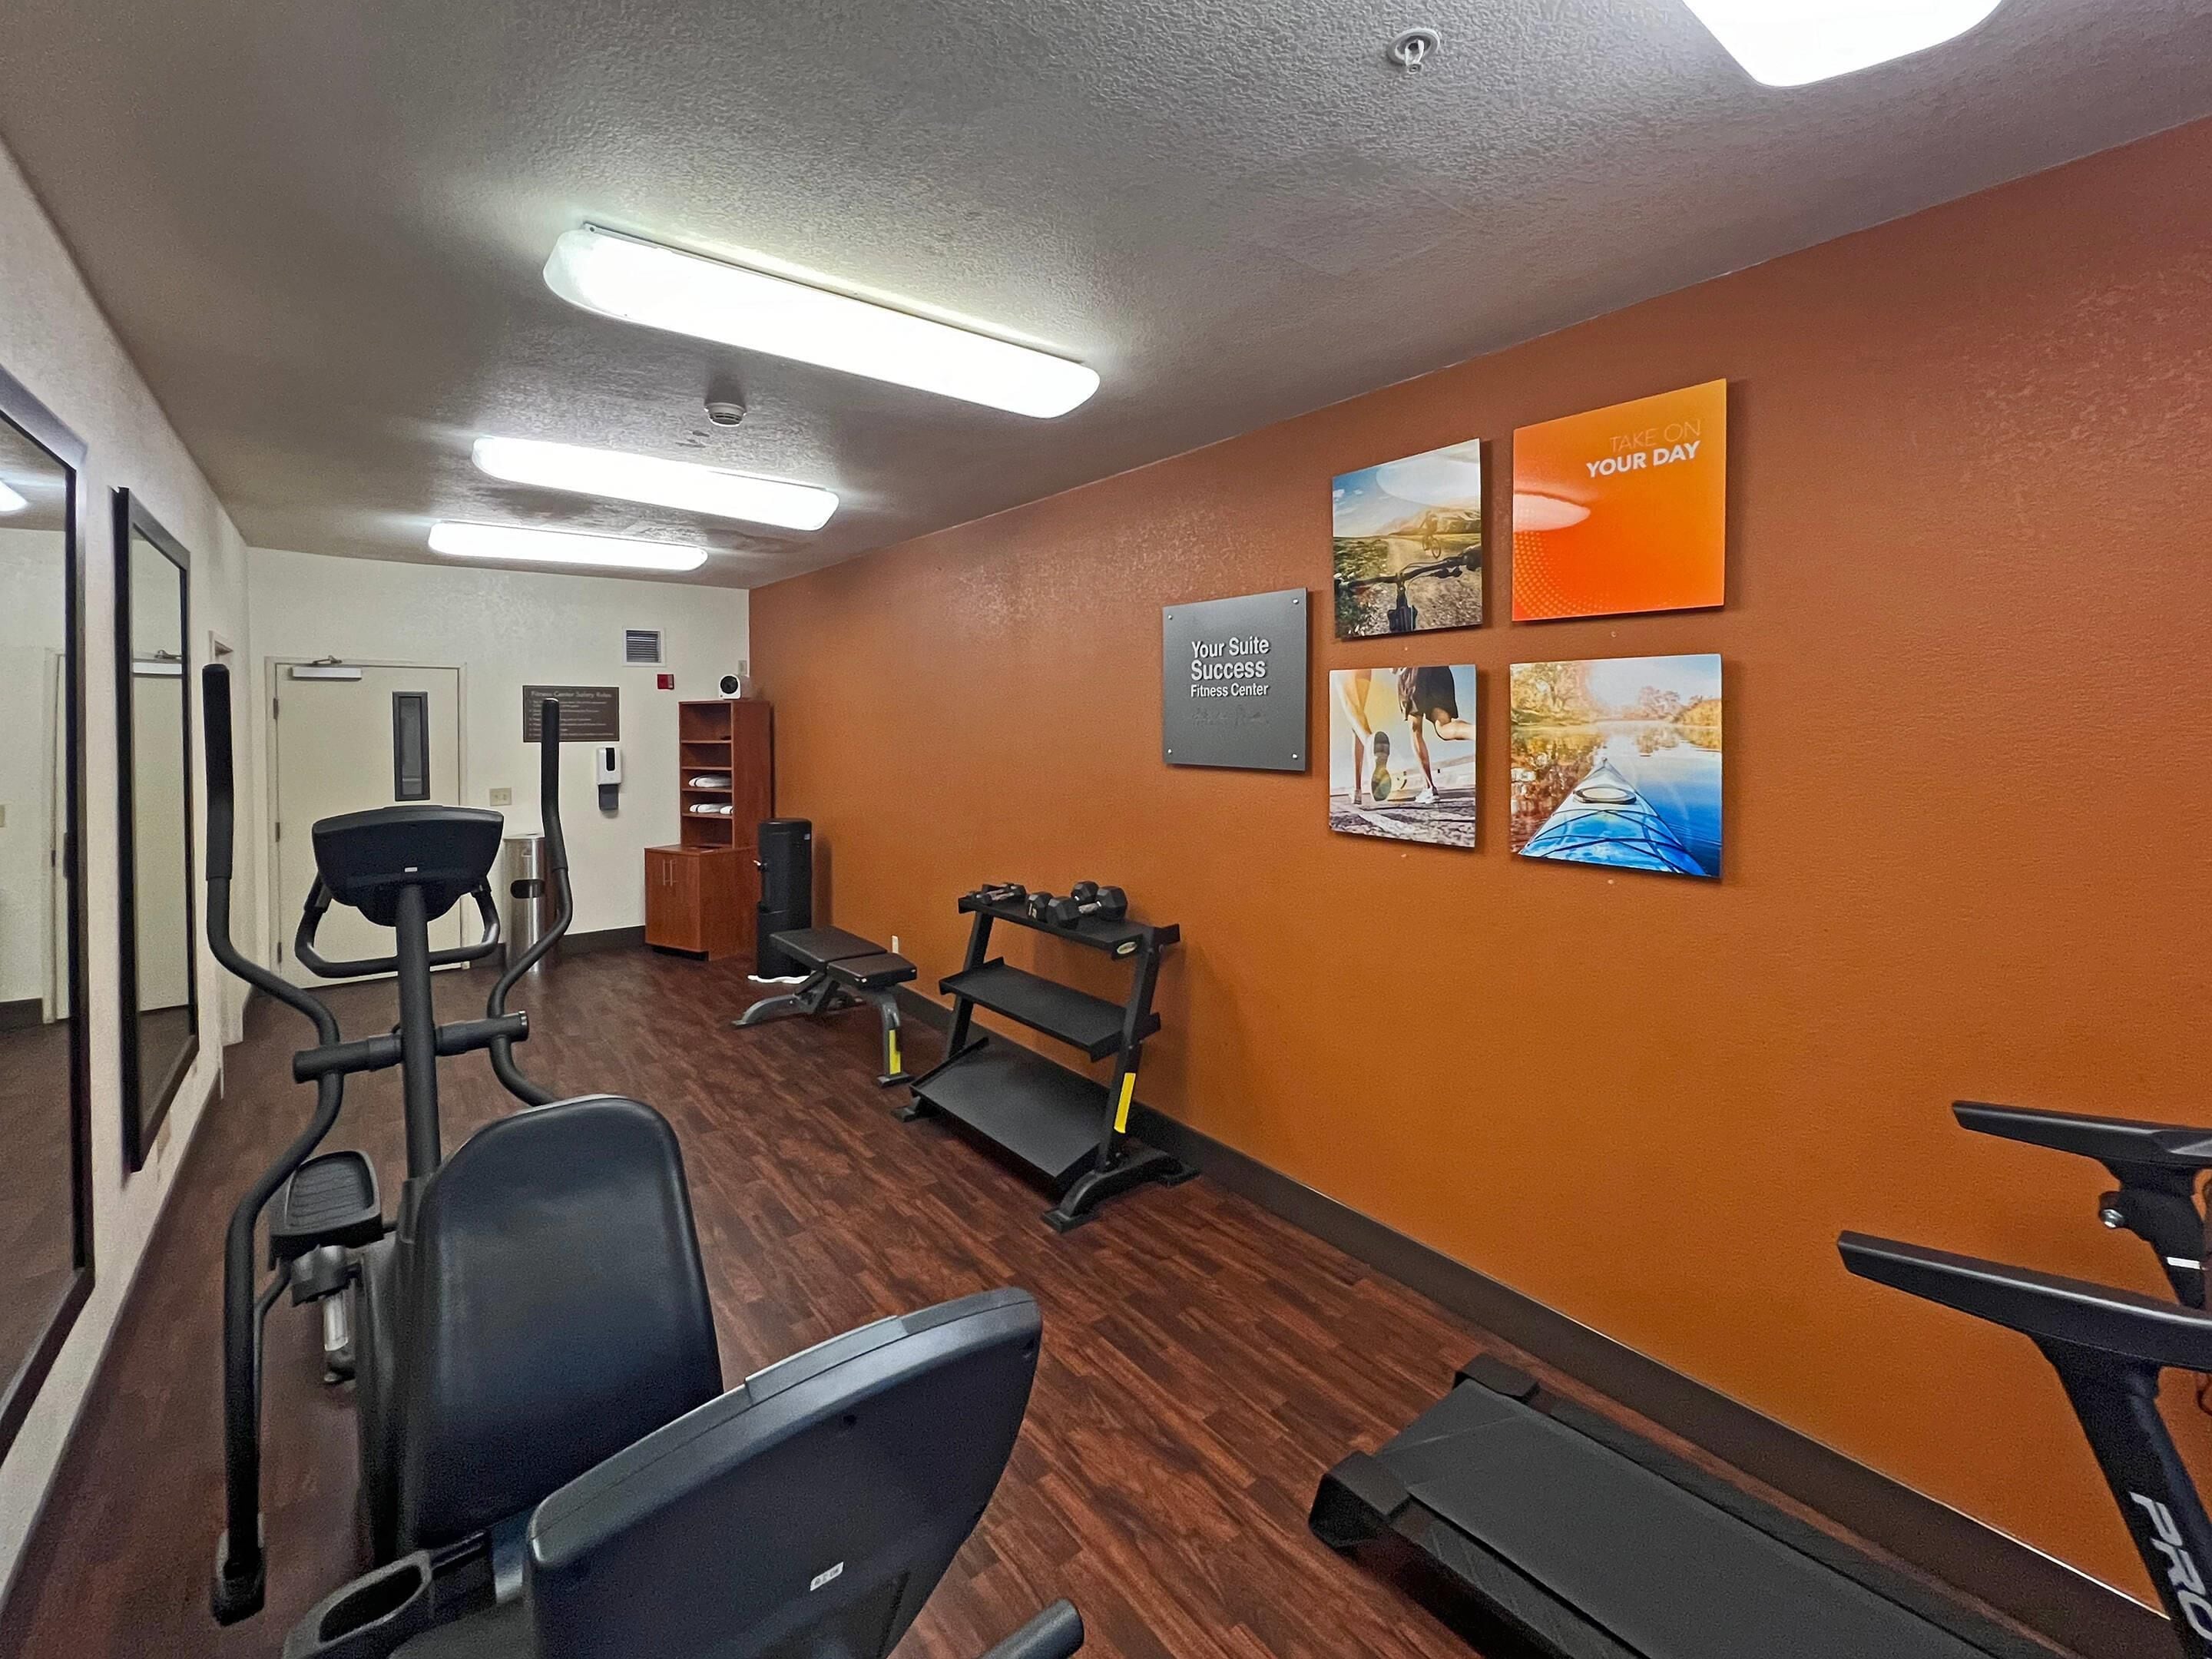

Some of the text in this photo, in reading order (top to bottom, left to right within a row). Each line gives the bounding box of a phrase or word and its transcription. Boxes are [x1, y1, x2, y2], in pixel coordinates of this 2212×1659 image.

[1610, 419, 1701, 453] TAKE ON
[1586, 440, 1700, 478] YOUR DAY
[1191, 636, 1270, 658] Your Suite
[1190, 660, 1266, 680] Success
[1190, 682, 1269, 697] Fitness Center
